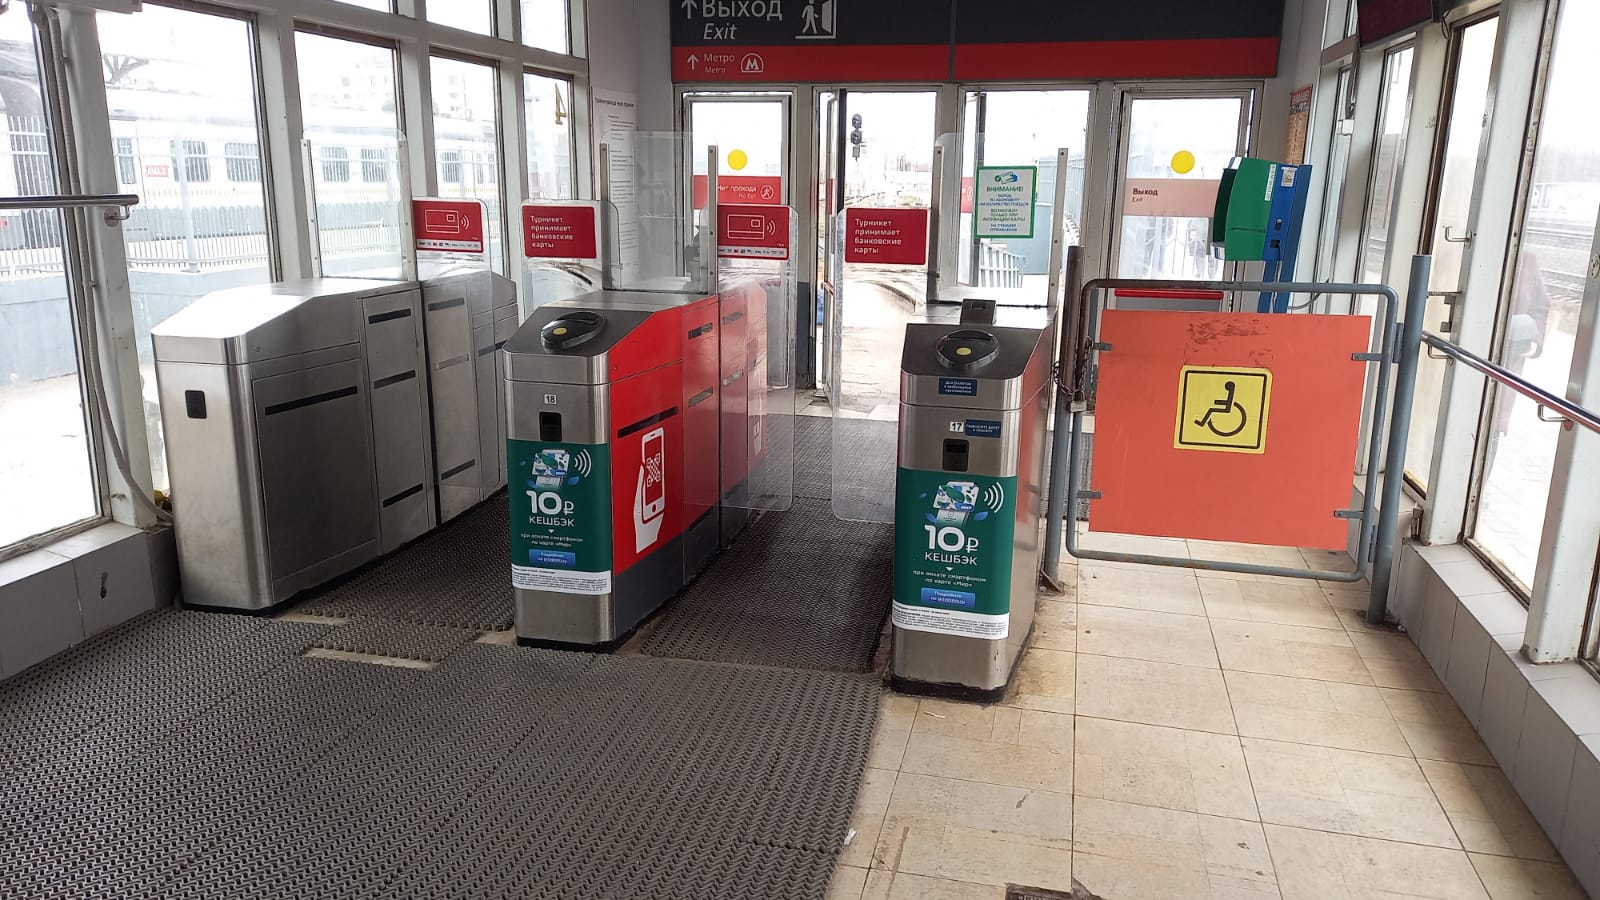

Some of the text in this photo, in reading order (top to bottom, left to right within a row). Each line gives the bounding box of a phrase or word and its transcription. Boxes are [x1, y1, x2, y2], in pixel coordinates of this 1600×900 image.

[702, 0, 783, 21] Выход
[703, 22, 738, 40] Exit
[704, 53, 735, 65] Метро
[705, 66, 726, 74] Metro
[730, 185, 757, 193] прохода
[1132, 187, 1158, 196] Выход
[530, 215, 563, 224] Турникет
[854, 218, 892, 228] Турникет
[530, 225, 571, 233] принимает
[854, 228, 901, 237] принимает
[531, 232, 573, 241] банковские
[854, 236, 902, 246] банковские
[531, 241, 554, 250] карты
[854, 246, 879, 255] карты
[546, 395, 555, 403] 18
[951, 422, 962, 432] 17
[528, 515, 575, 527] КЕШБЭК
[924, 551, 978, 566] КЕШБЭК
[948, 574, 987, 583] смартфоном
